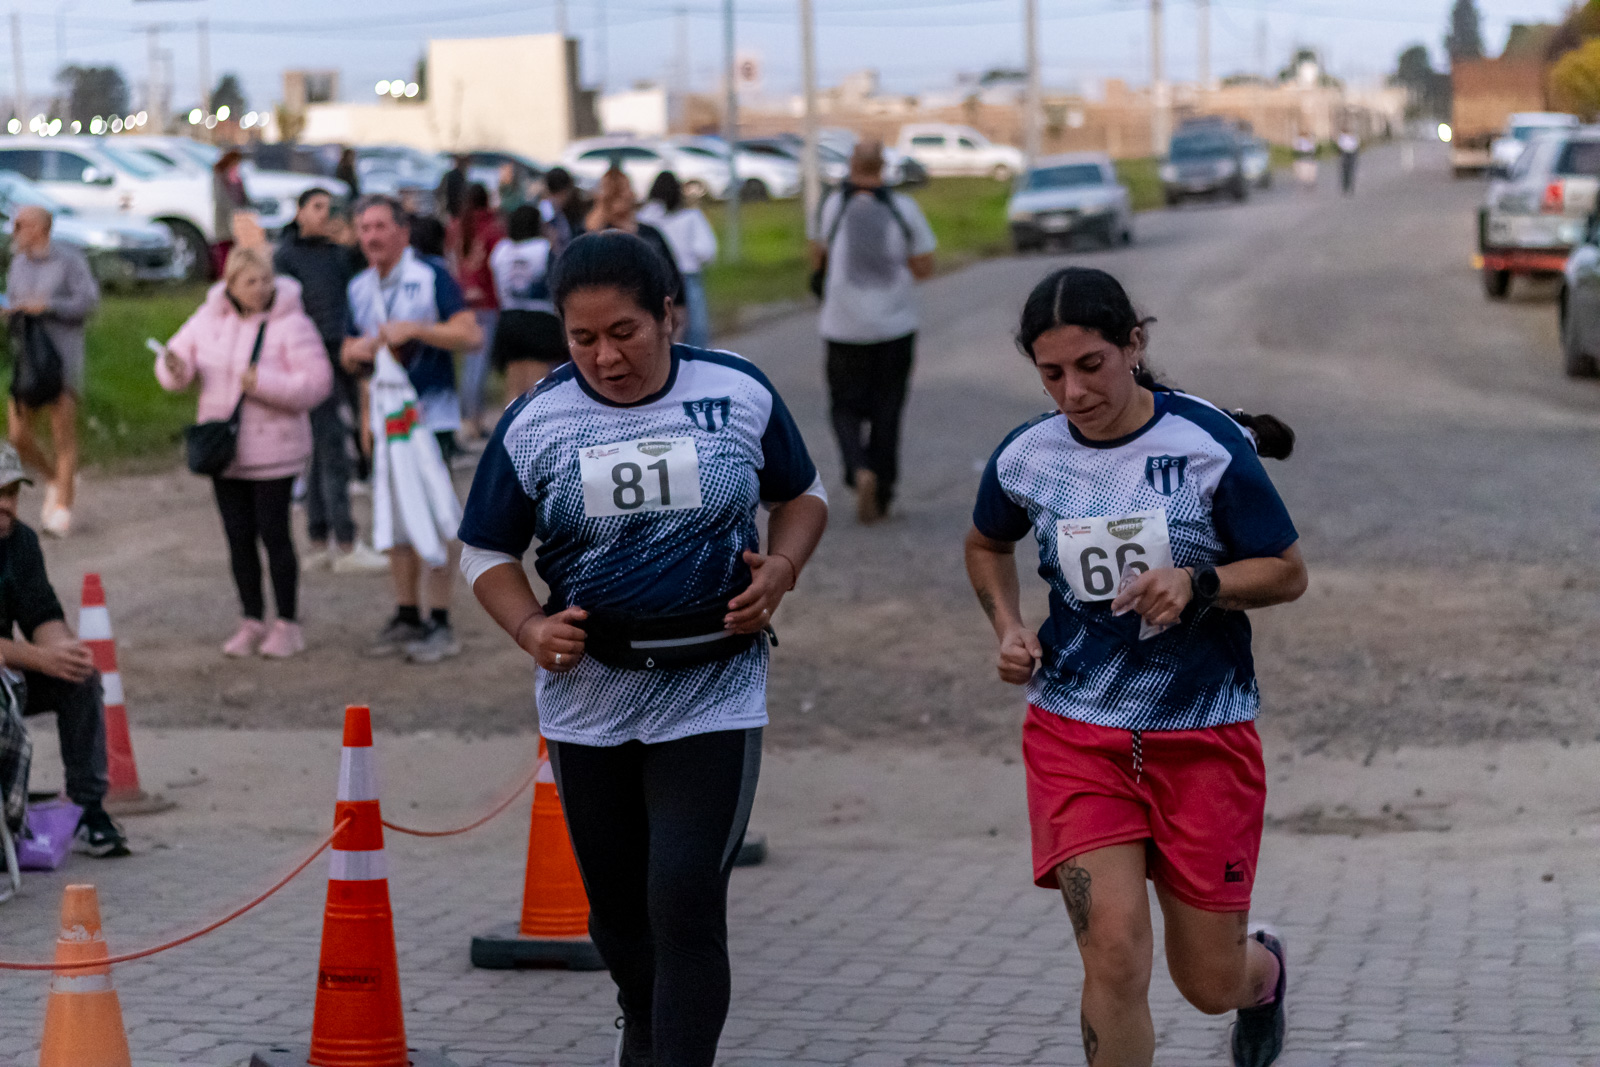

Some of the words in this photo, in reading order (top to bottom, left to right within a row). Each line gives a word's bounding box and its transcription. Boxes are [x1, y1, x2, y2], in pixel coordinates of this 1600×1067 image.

[692, 401, 722, 413] SFC
[1152, 458, 1179, 469] SFC
[611, 459, 671, 510] 81
